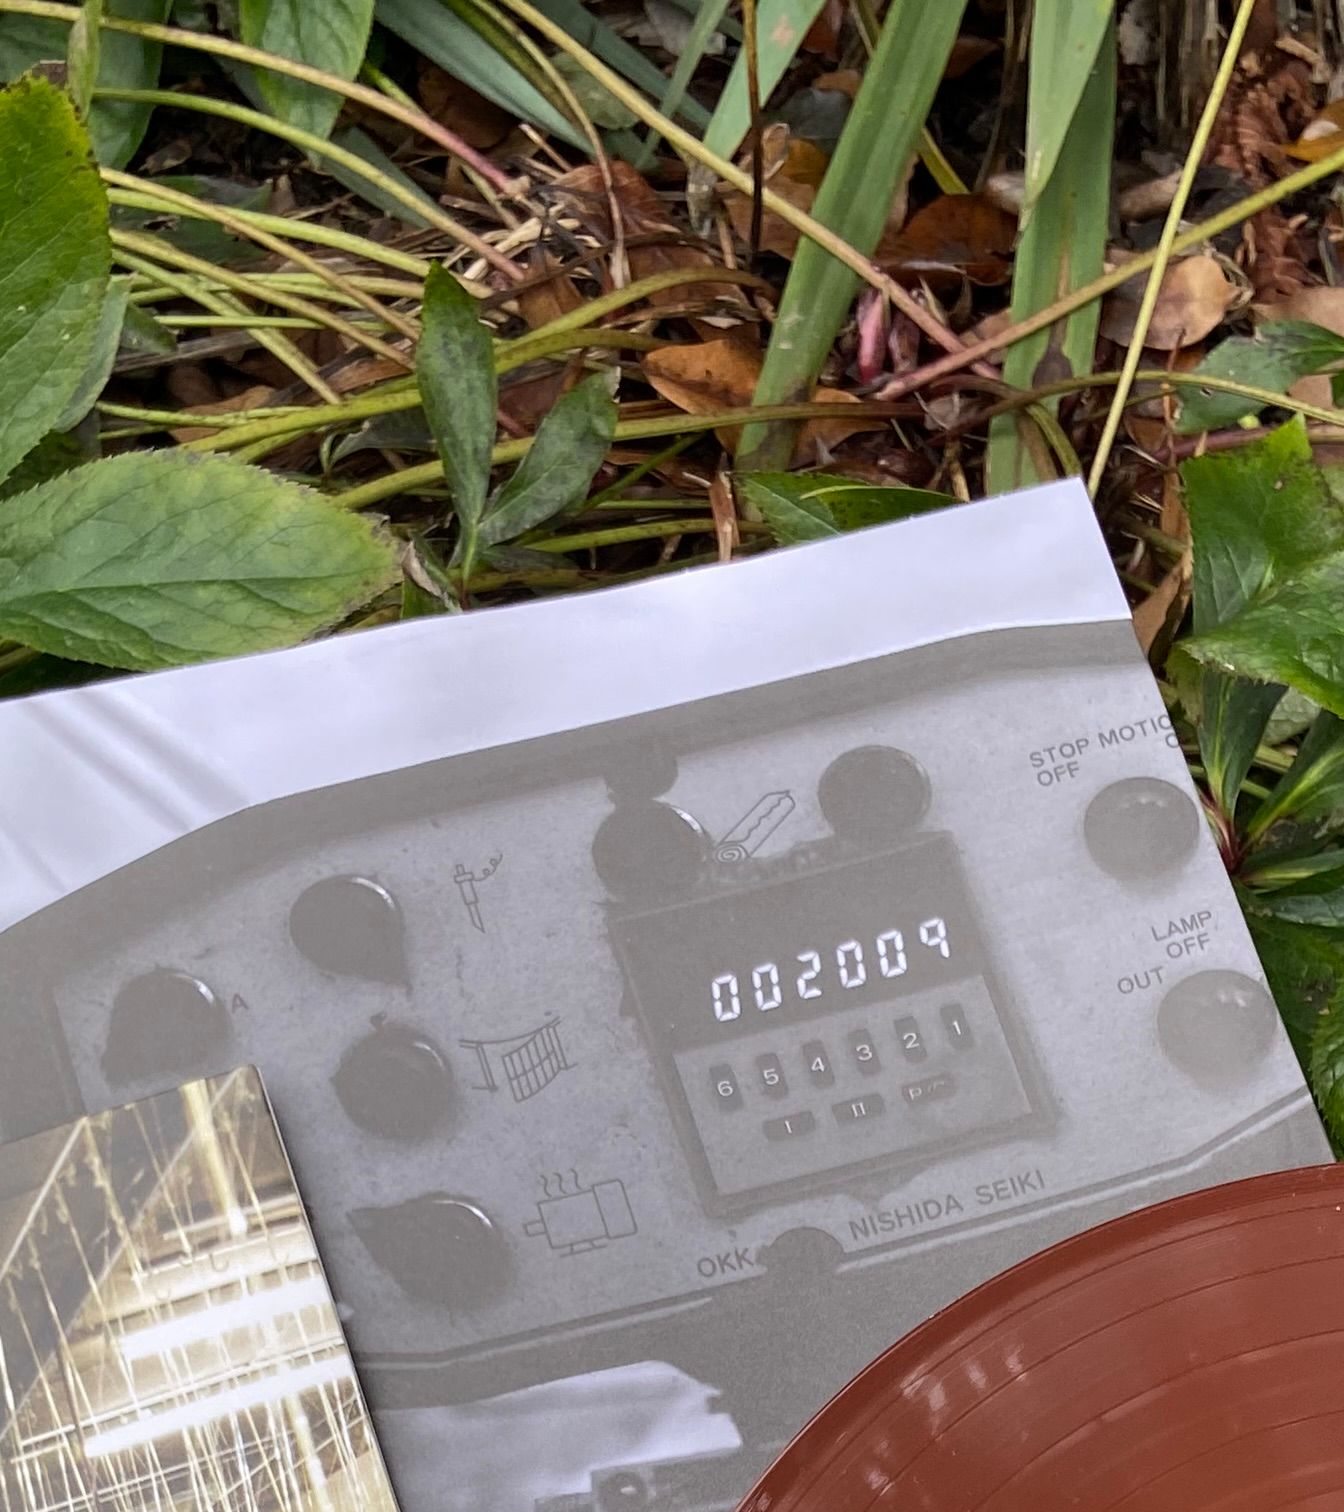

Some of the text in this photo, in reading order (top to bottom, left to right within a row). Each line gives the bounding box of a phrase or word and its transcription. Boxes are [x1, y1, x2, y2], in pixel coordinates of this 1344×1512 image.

[1029, 738, 1090, 768] STOP
[1036, 761, 1080, 788] OFF
[1151, 910, 1213, 942] LAMP
[1165, 933, 1212, 959] OFF
[711, 916, 951, 1022] 002009
[1117, 967, 1164, 995] OUT
[716, 1079, 734, 1098] 6
[763, 1068, 780, 1086] 5
[811, 1056, 826, 1073] 4
[856, 1043, 874, 1062] 3
[903, 1032, 920, 1050] 2
[847, 1193, 965, 1241] NISHIDA
[974, 1169, 1047, 1206] SEIKI
